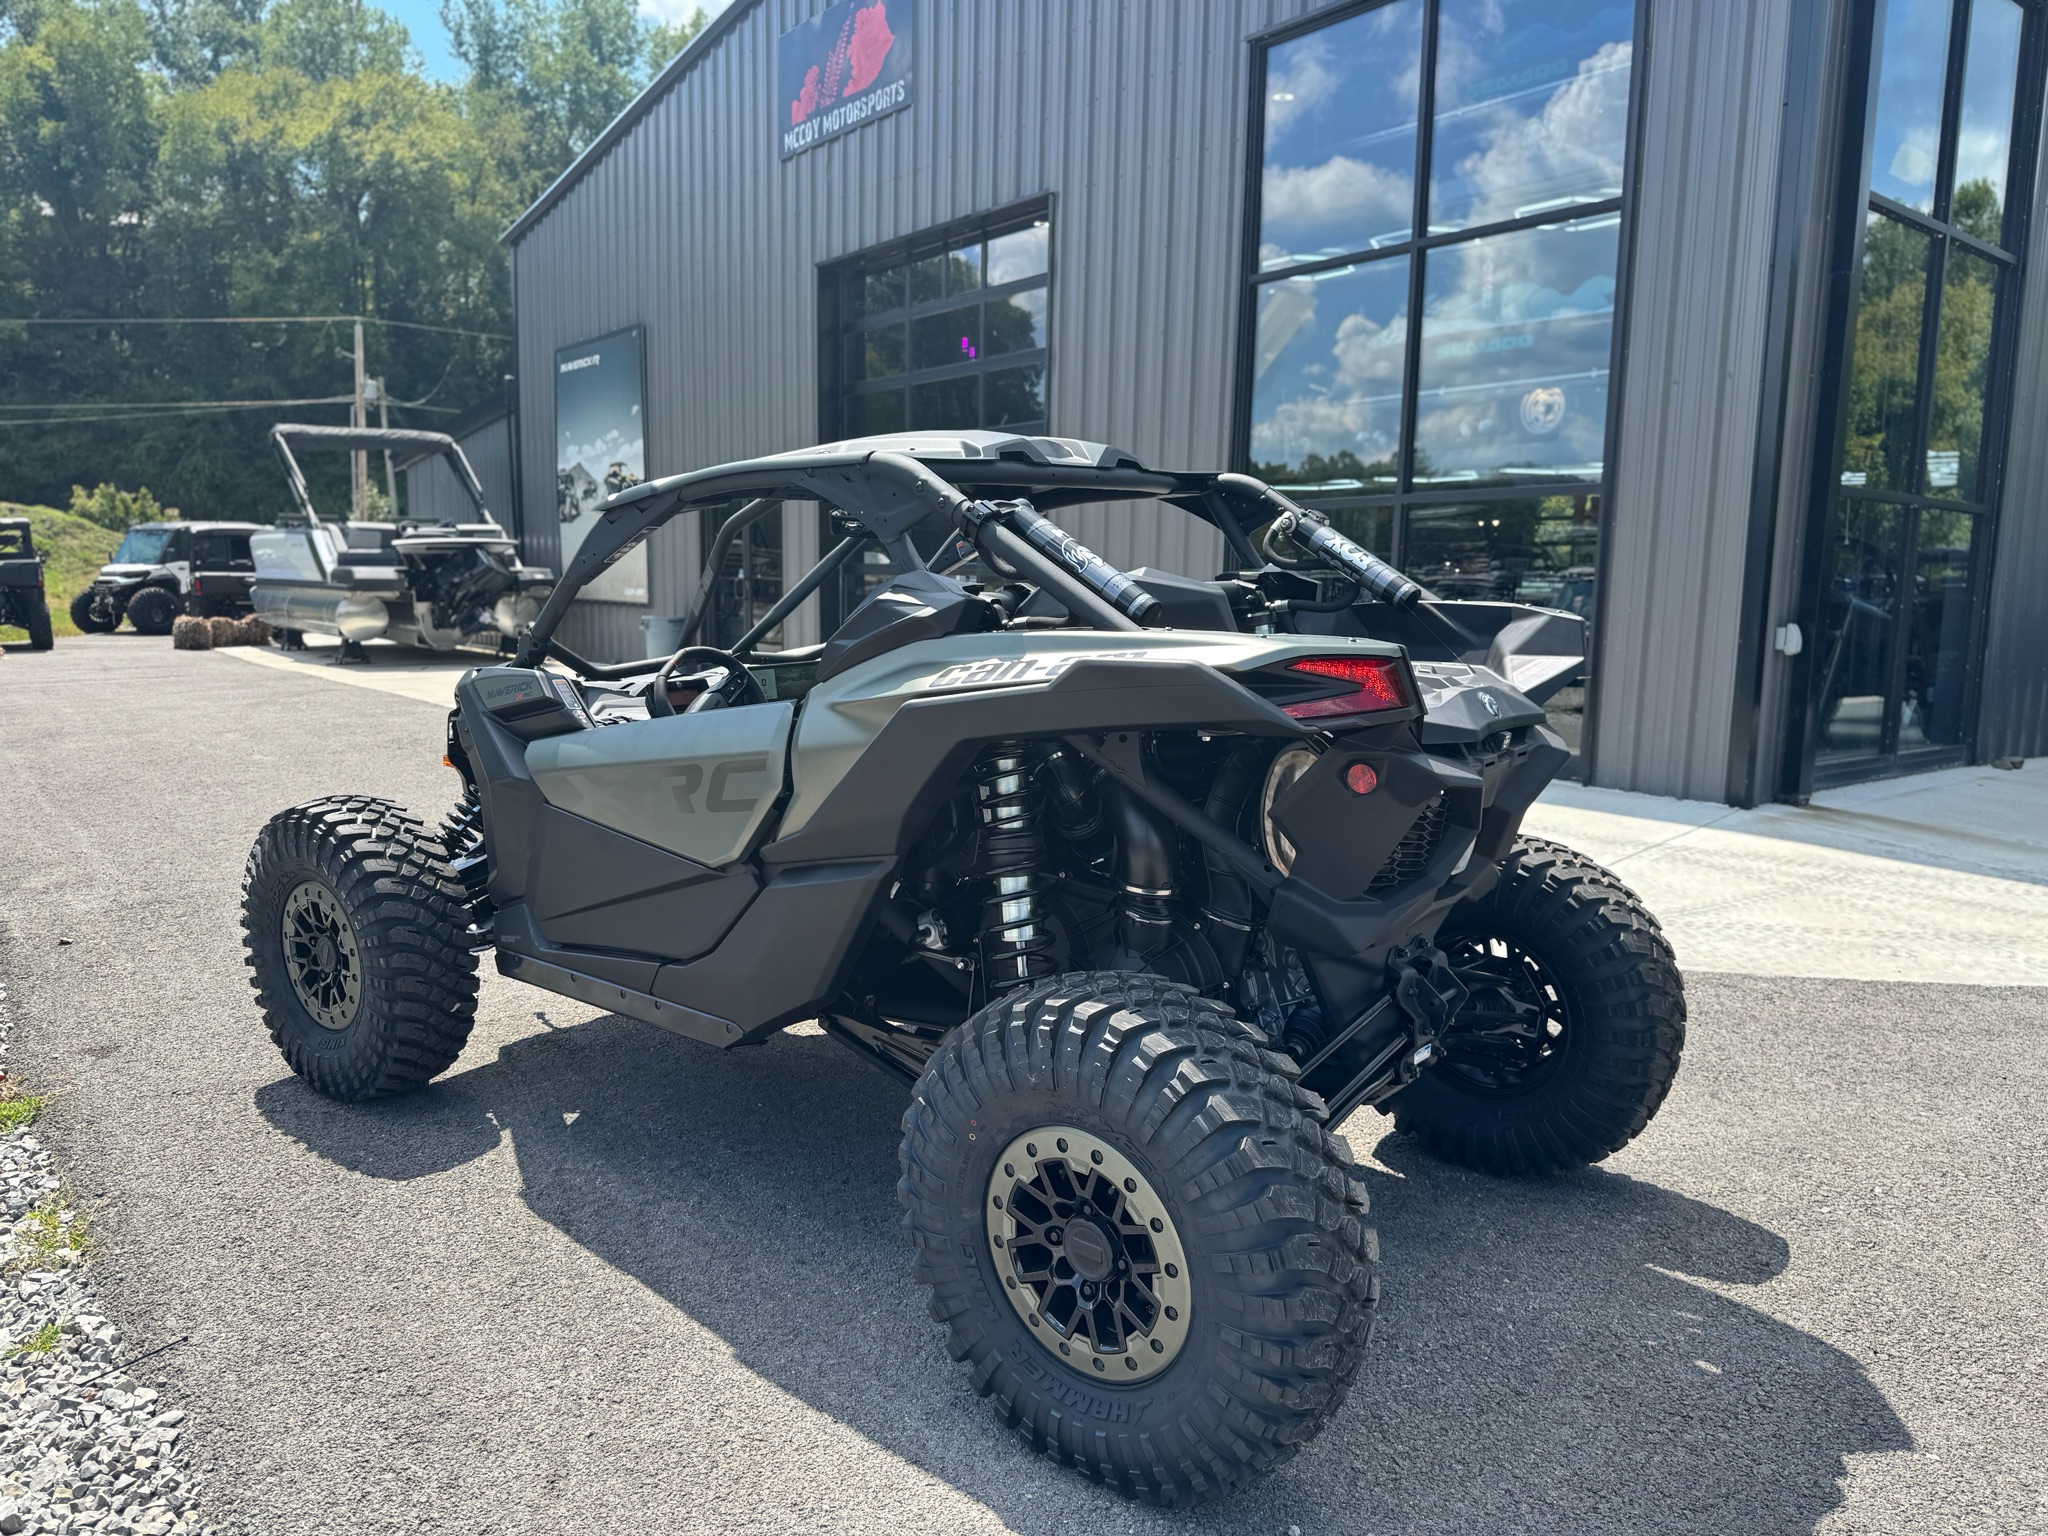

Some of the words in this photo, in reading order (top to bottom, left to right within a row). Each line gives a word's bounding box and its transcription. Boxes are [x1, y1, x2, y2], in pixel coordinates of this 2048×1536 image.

[784, 116, 821, 153] MCCOY
[823, 79, 905, 136] MOTORSPORTS
[486, 679, 535, 701] MAVERICK
[960, 1243, 1002, 1323] KING
[1008, 1339, 1129, 1423] HAMMER
